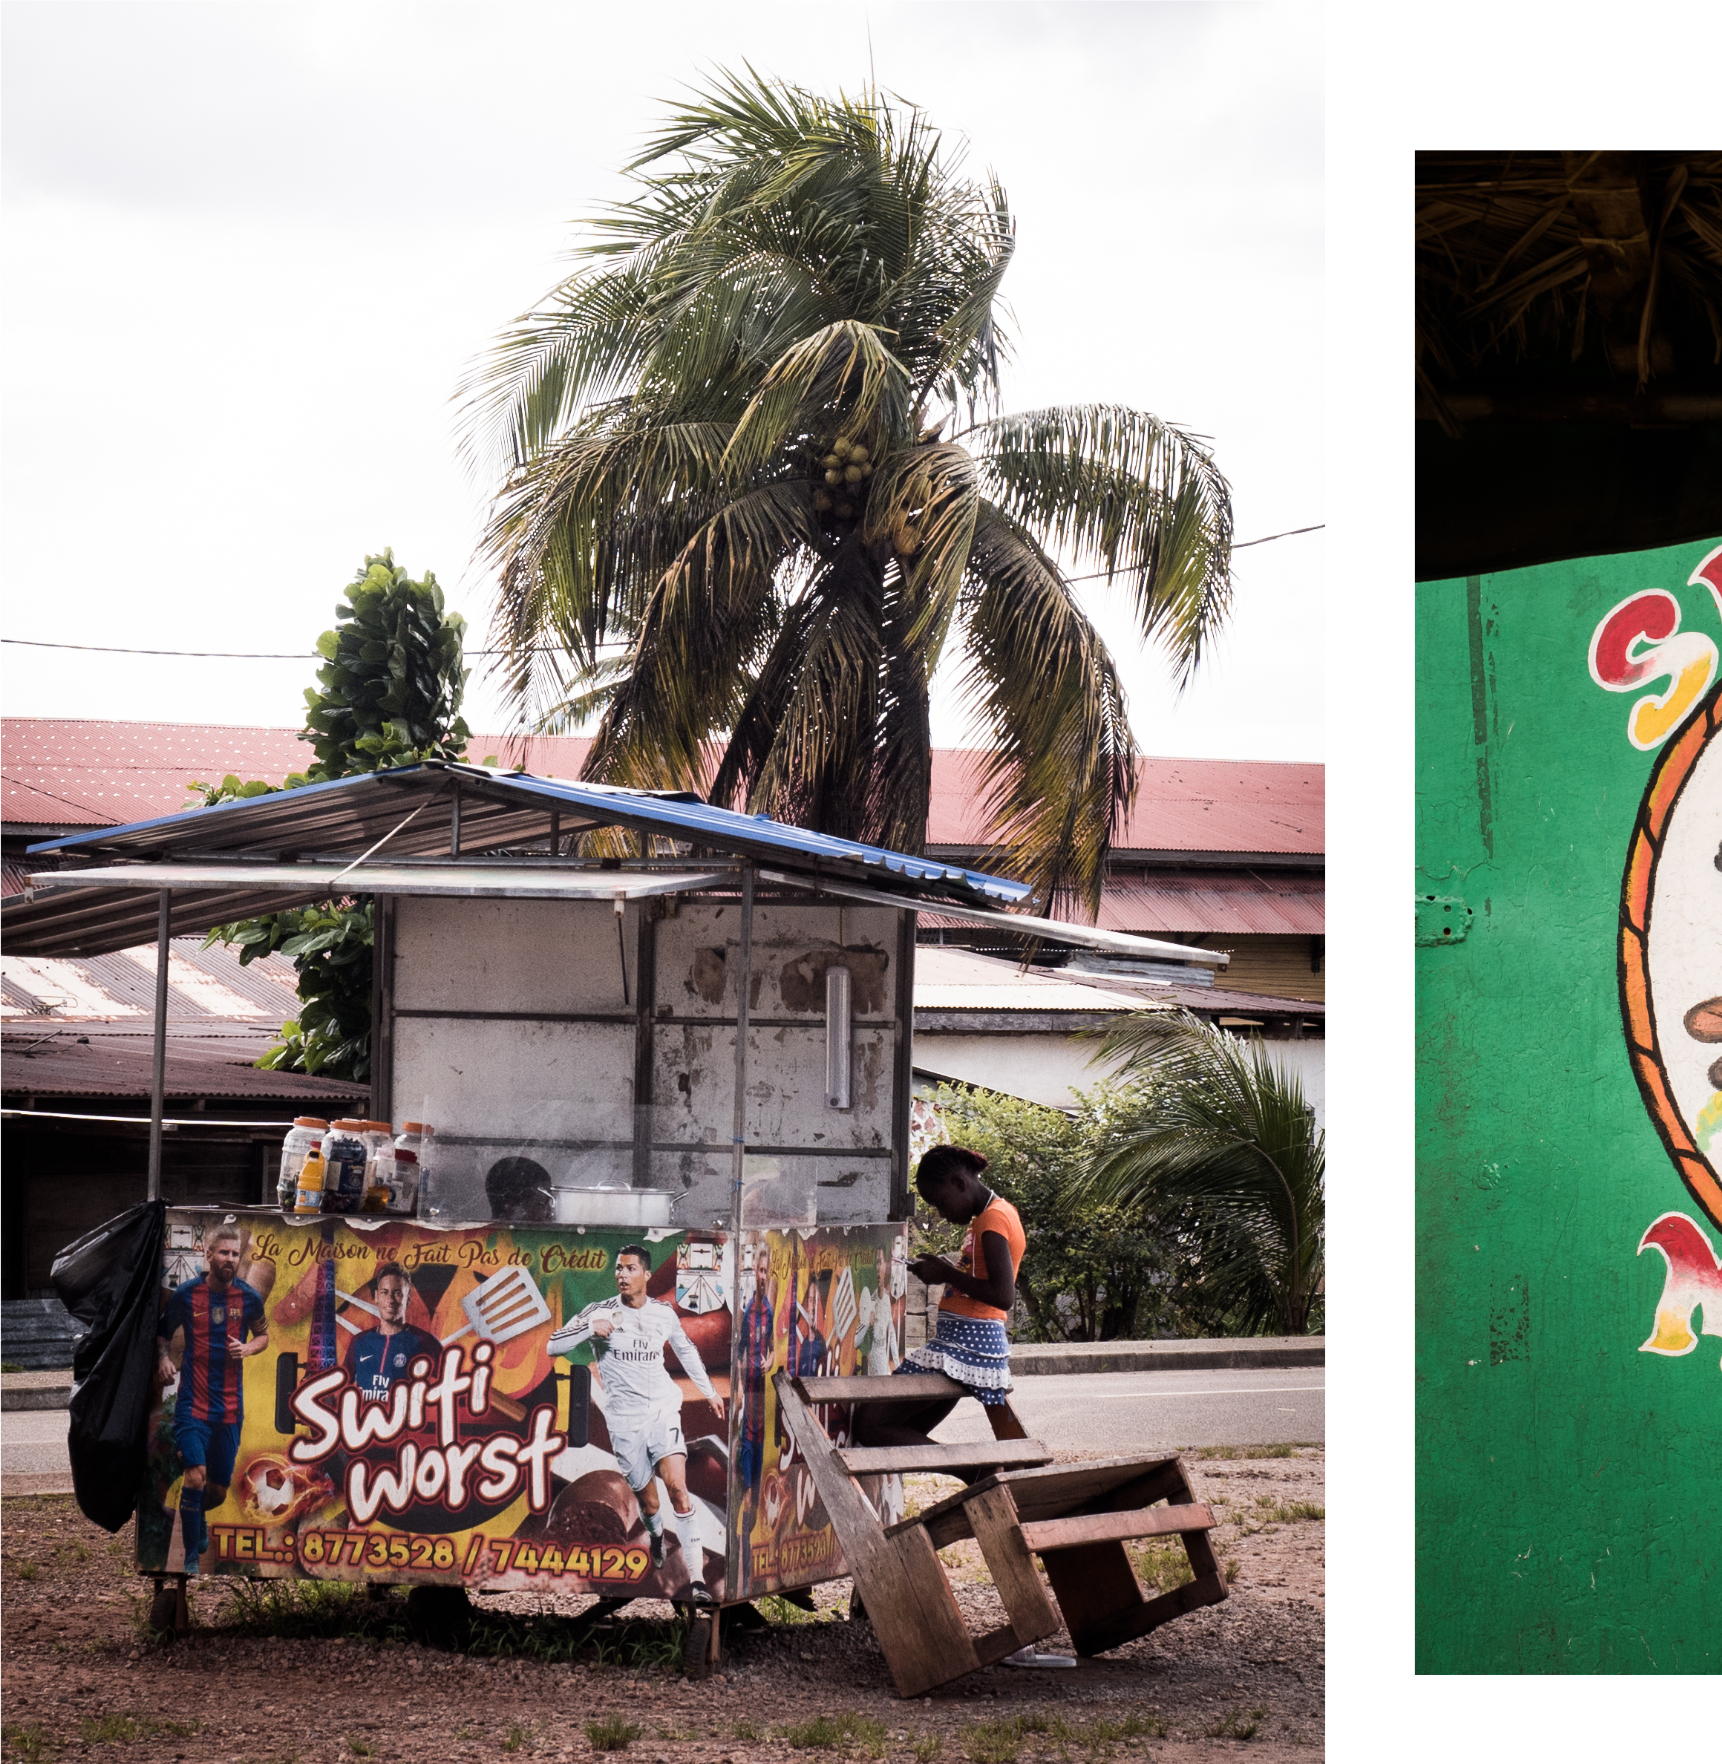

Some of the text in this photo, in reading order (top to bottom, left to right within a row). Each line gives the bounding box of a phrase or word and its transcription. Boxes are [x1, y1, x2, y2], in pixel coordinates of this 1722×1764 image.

[251, 1233, 607, 1274] La Maison ne Fait Pas de Crédit
[633, 1339, 648, 1350] Fly
[372, 1374, 390, 1388] Fly
[290, 1341, 494, 1463] Switi
[669, 1426, 680, 1444] 7
[212, 1526, 650, 1580] TEL.: 8773528 / 7444129
